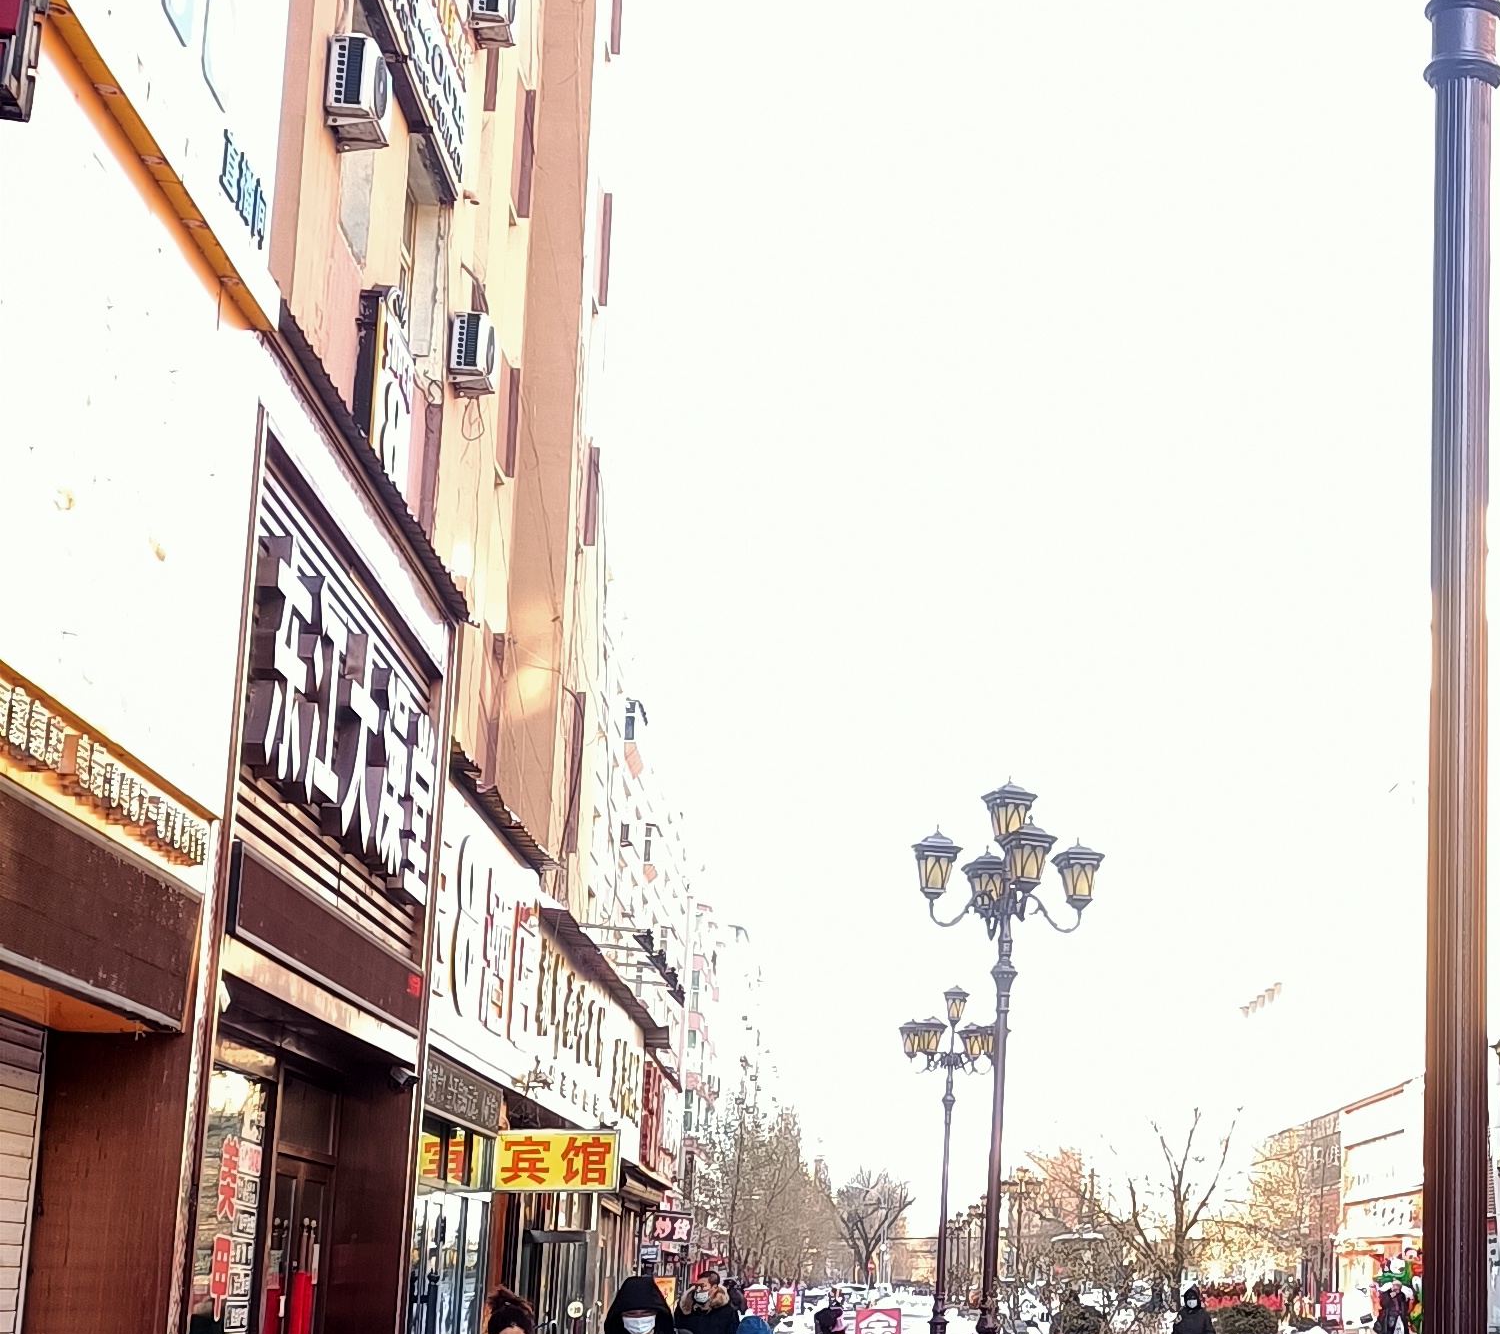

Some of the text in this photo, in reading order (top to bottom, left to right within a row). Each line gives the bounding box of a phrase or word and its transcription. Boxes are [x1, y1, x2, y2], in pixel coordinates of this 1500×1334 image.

[262, 549, 437, 887] 东江大澡堂
[500, 1136, 612, 1186] 宾馆
[653, 1216, 692, 1242] 炒货
